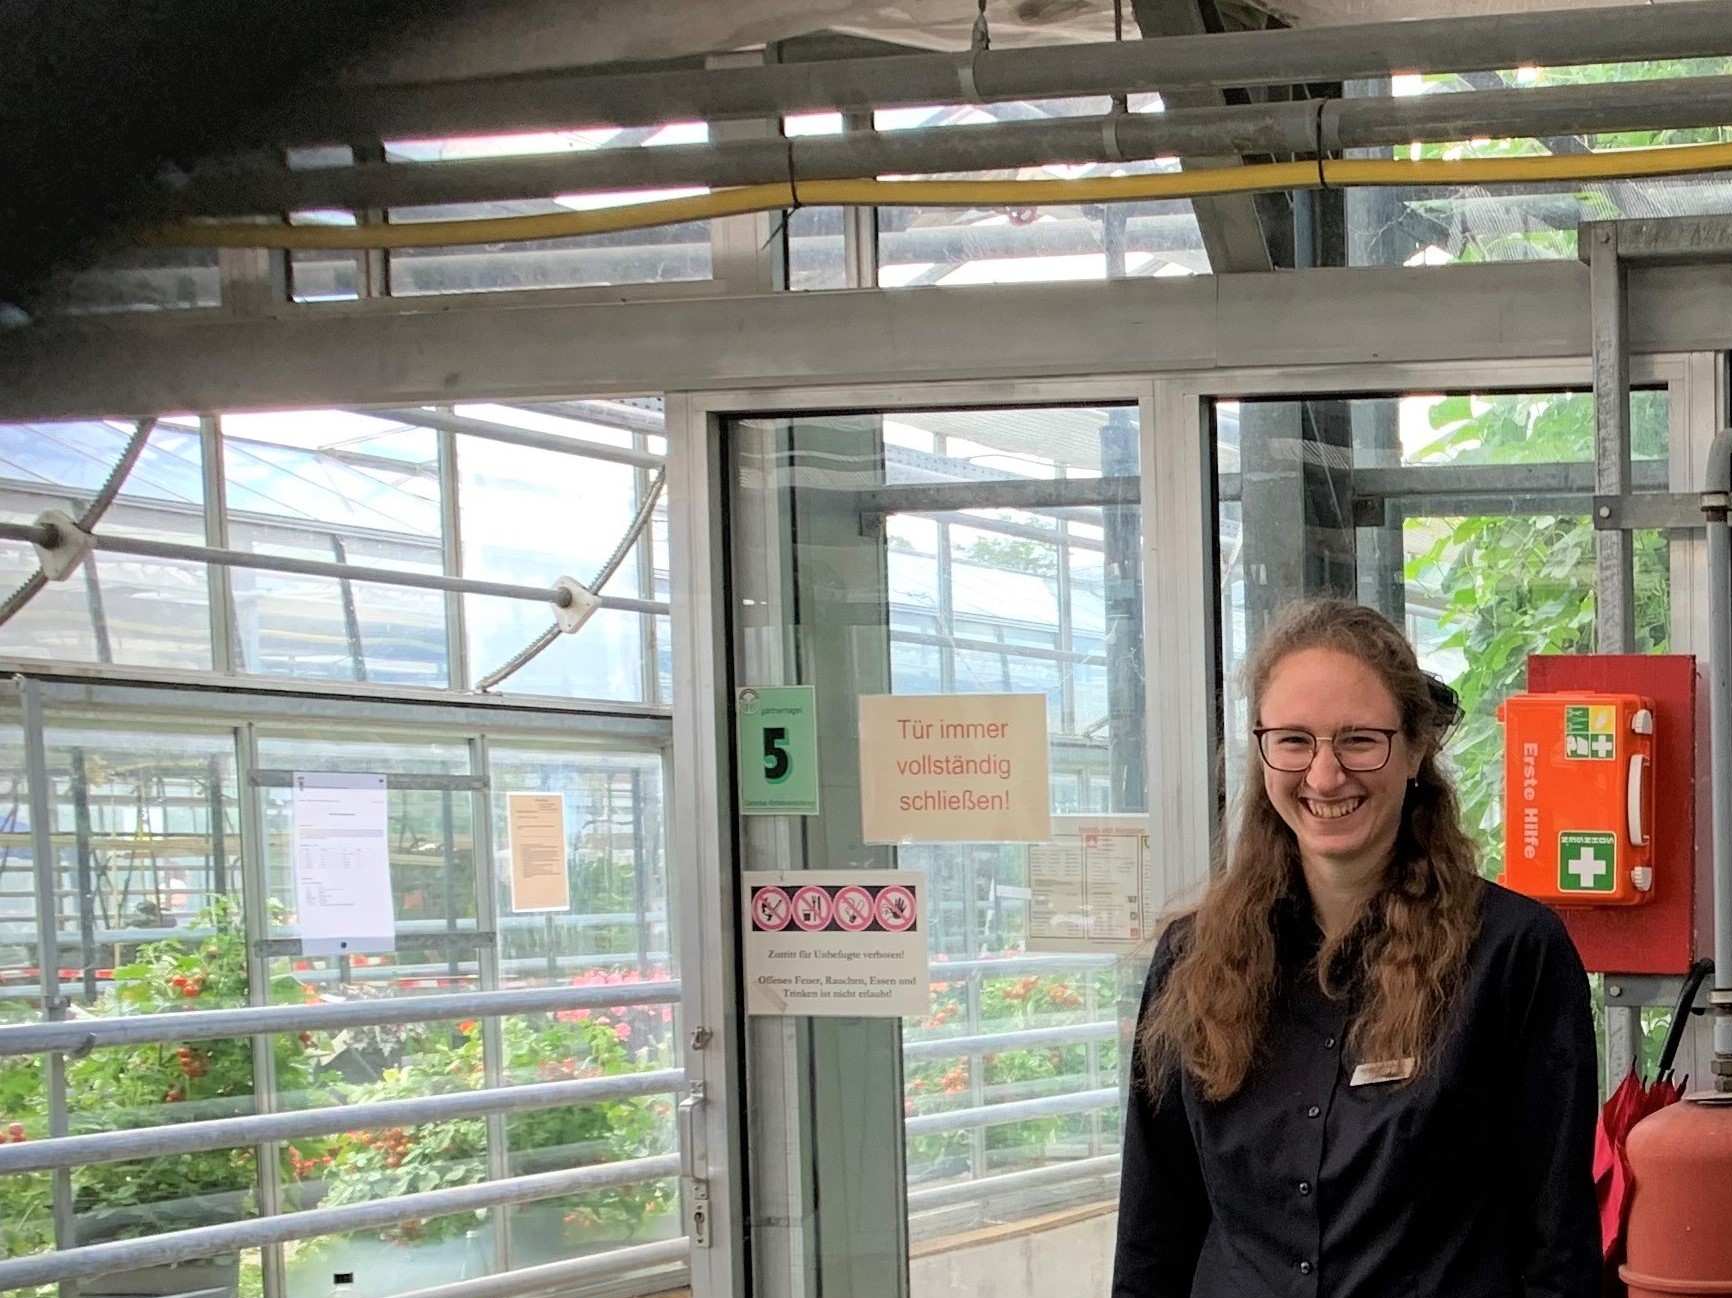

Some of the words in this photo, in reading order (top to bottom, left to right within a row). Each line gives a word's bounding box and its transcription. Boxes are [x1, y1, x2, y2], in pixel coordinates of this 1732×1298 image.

[897, 718, 934, 739] Tür
[940, 719, 1009, 739] immer
[762, 727, 790, 780] 5
[897, 755, 1012, 780] vollständig
[1523, 742, 1539, 801] Erste
[900, 791, 1010, 811] schließen!
[1523, 807, 1539, 860] Hilfe
[767, 949, 797, 959] Zutritt
[799, 949, 812, 959] für
[814, 949, 861, 961] Unbefugte
[758, 976, 792, 985] Offenes
[794, 976, 823, 986] Feuer,
[825, 976, 867, 986] Rauchen,
[869, 976, 896, 985] Essen
[898, 976, 916, 985] und
[783, 989, 817, 998] Trinken
[820, 989, 831, 998] ist
[833, 989, 856, 998] nicht
[858, 989, 892, 998] erlaubt!
